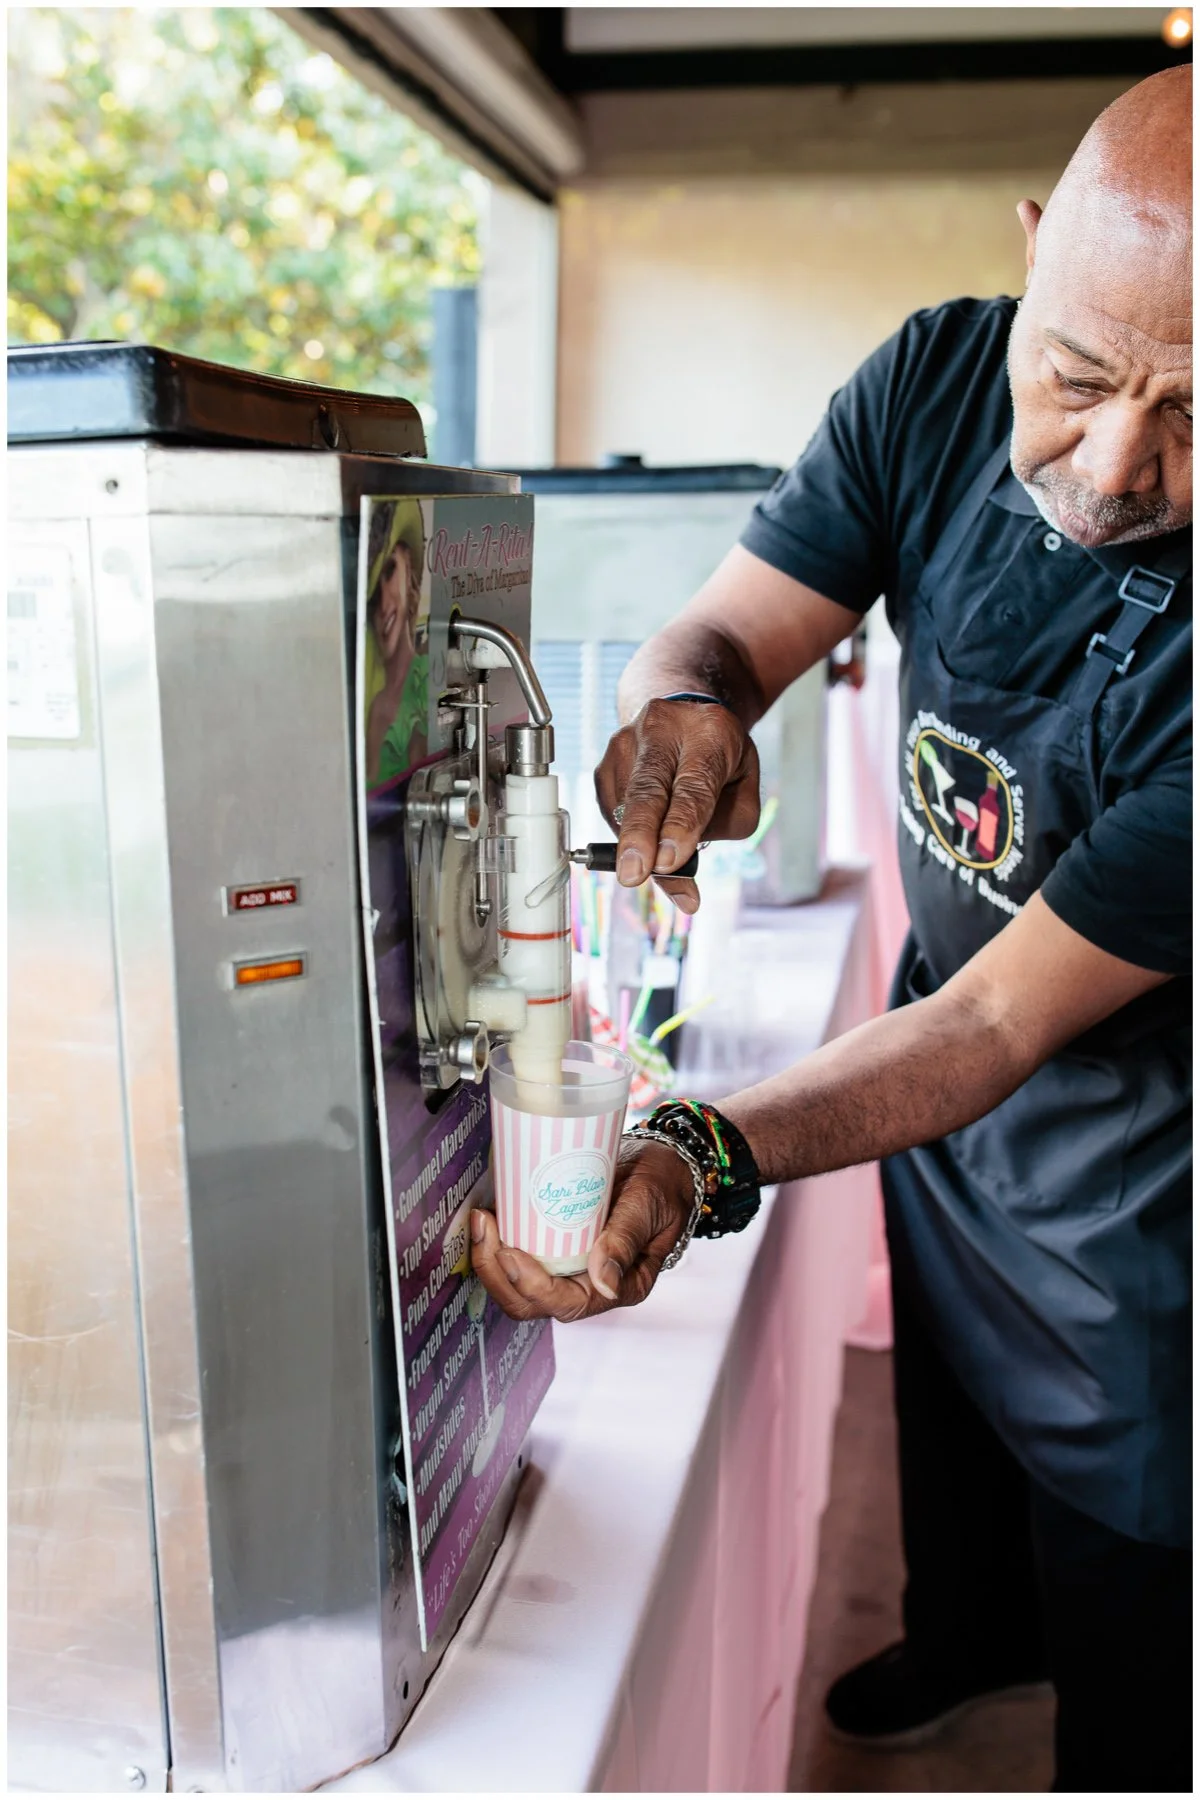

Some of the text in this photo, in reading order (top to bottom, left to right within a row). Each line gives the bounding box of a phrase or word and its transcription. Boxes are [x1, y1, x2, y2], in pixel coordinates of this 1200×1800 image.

[433, 522, 534, 578] Rent-A-Rita!
[985, 747, 1018, 780] and
[1010, 784, 1025, 847] Server
[398, 1092, 487, 1222] Gourmet Margaritas
[538, 1175, 606, 1200] Sari Blair
[403, 1243, 424, 1280] Top
[421, 1208, 446, 1254] Shelf
[407, 1295, 430, 1336] Pina
[411, 1328, 442, 1391] Frozen
[414, 1378, 444, 1442] Virgin
[419, 1396, 466, 1497] Mudslides
[420, 1505, 439, 1557] And
[438, 1456, 463, 1518] Many
